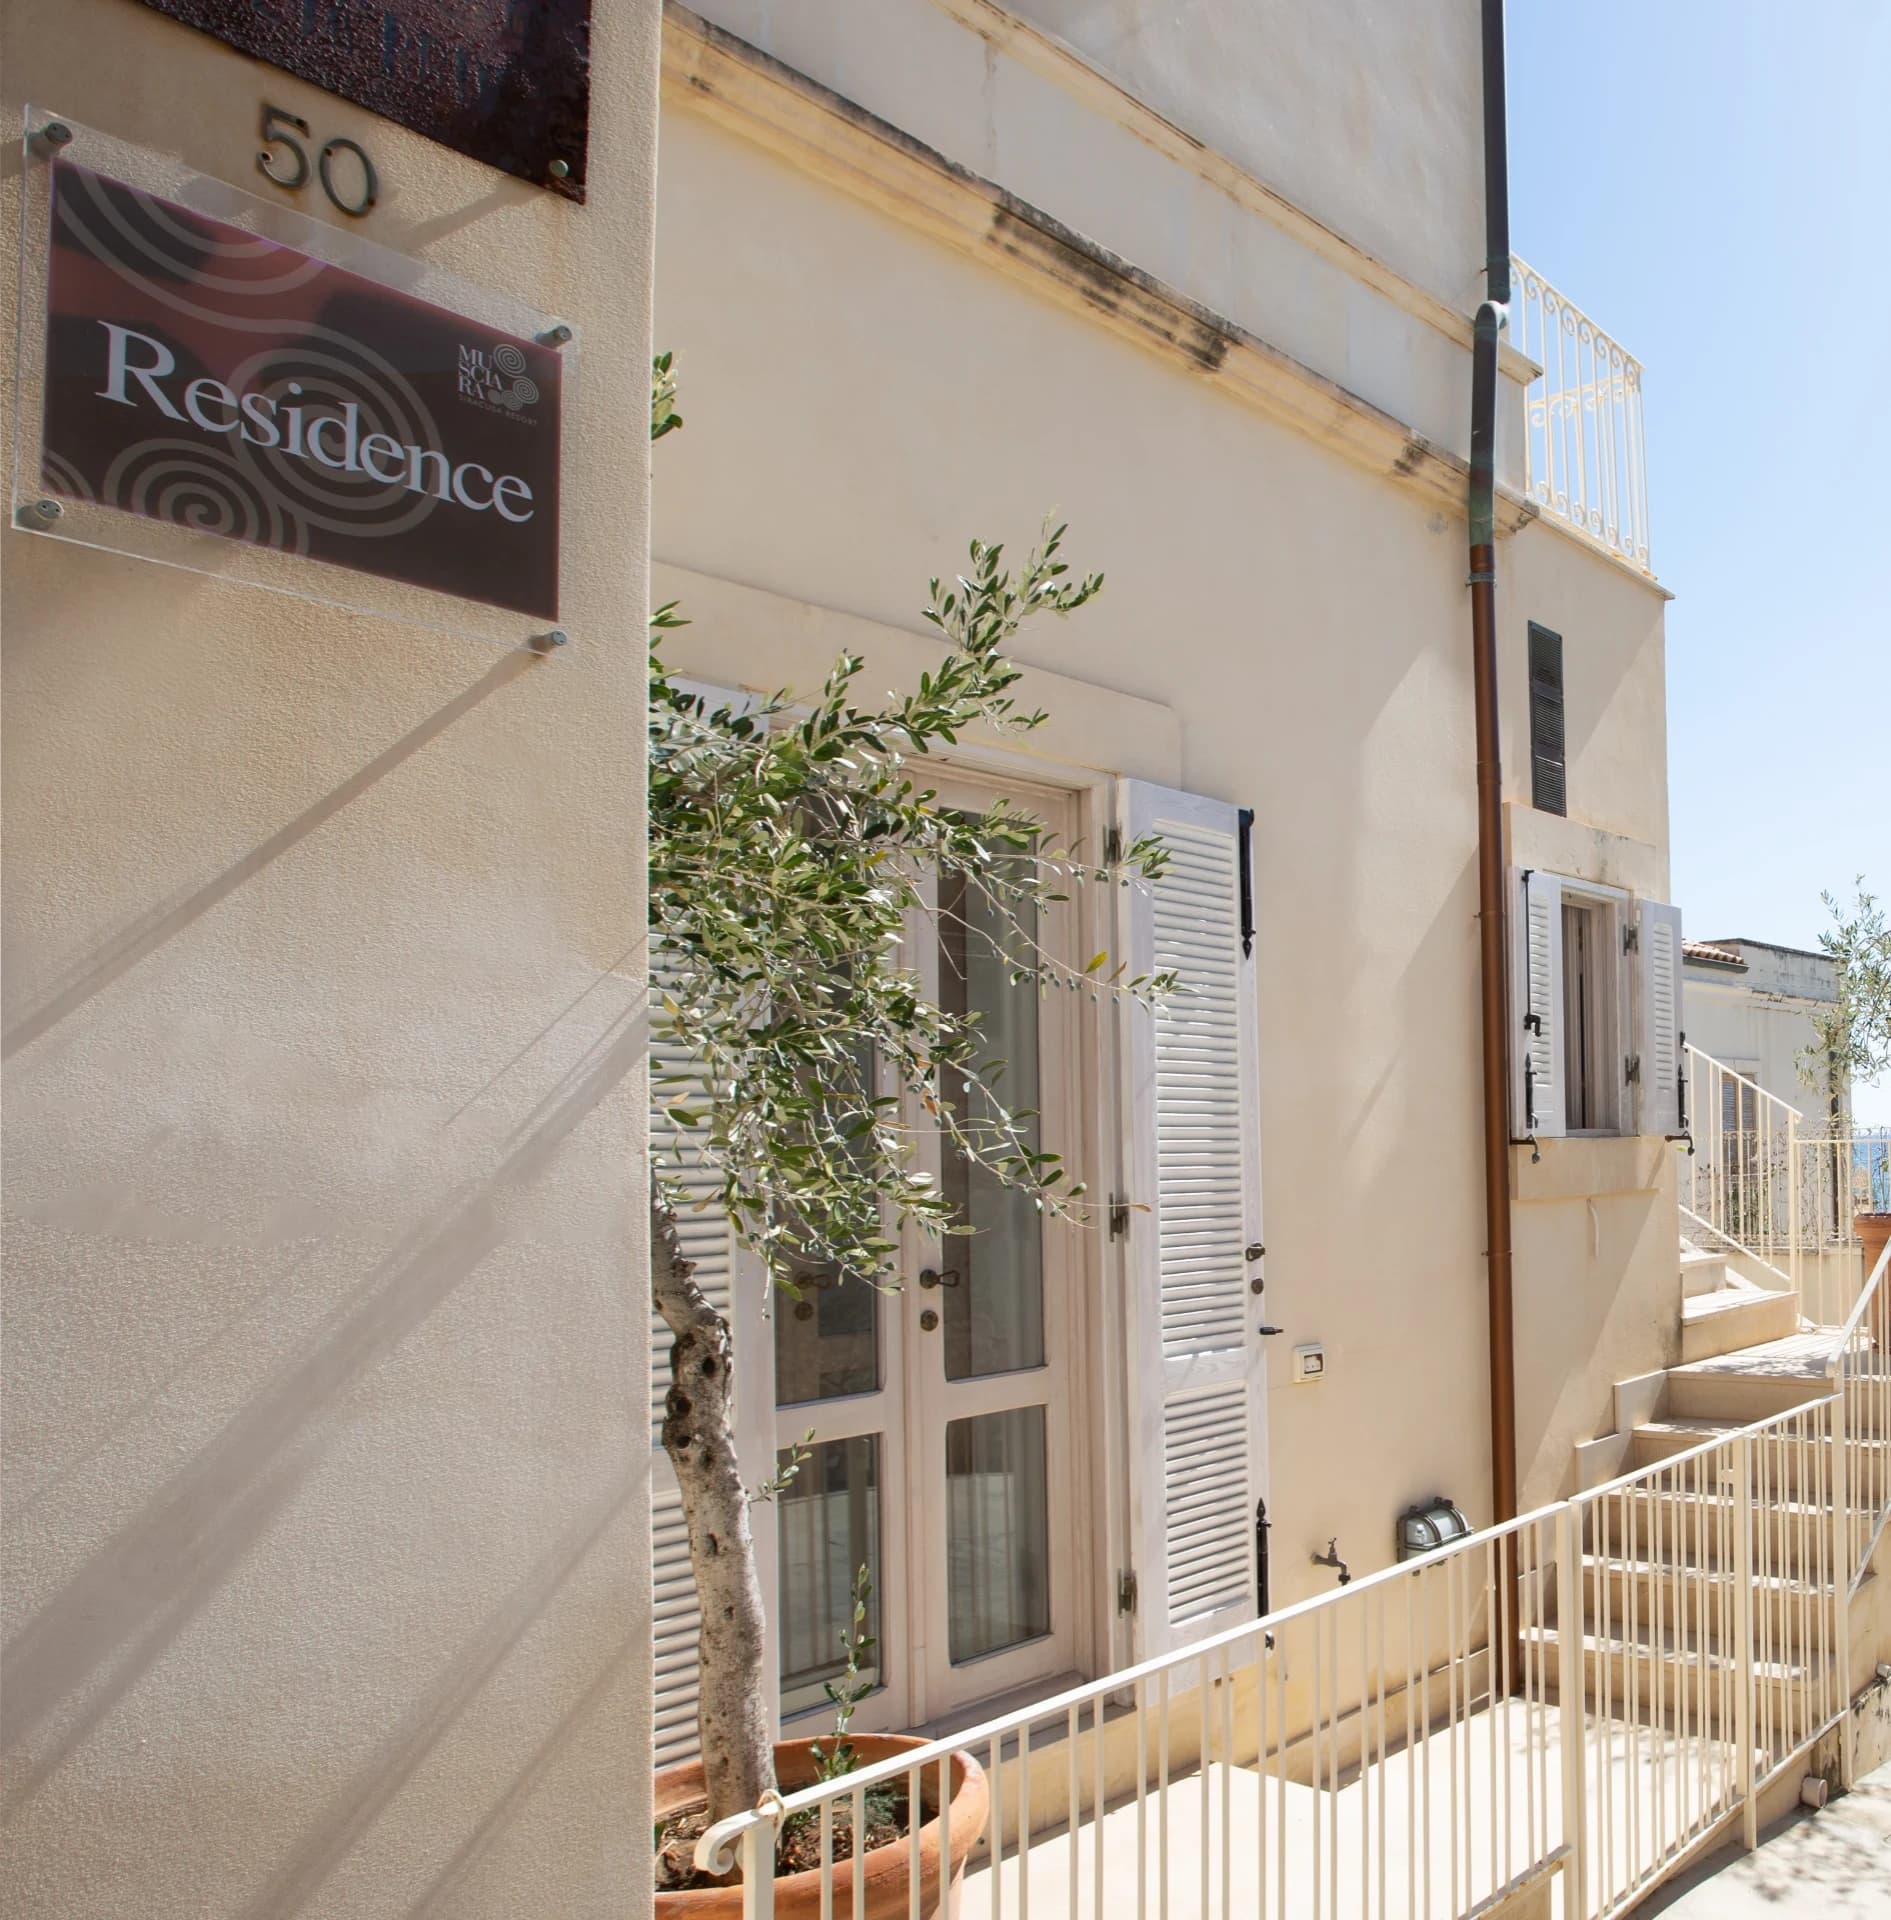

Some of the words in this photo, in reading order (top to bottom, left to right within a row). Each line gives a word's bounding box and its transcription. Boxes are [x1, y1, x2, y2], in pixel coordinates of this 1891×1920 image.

[256, 103, 378, 217] 50
[459, 344, 494, 369] MU
[459, 362, 503, 391] SCIA
[459, 375, 486, 400] RA
[95, 320, 534, 523] Residence
